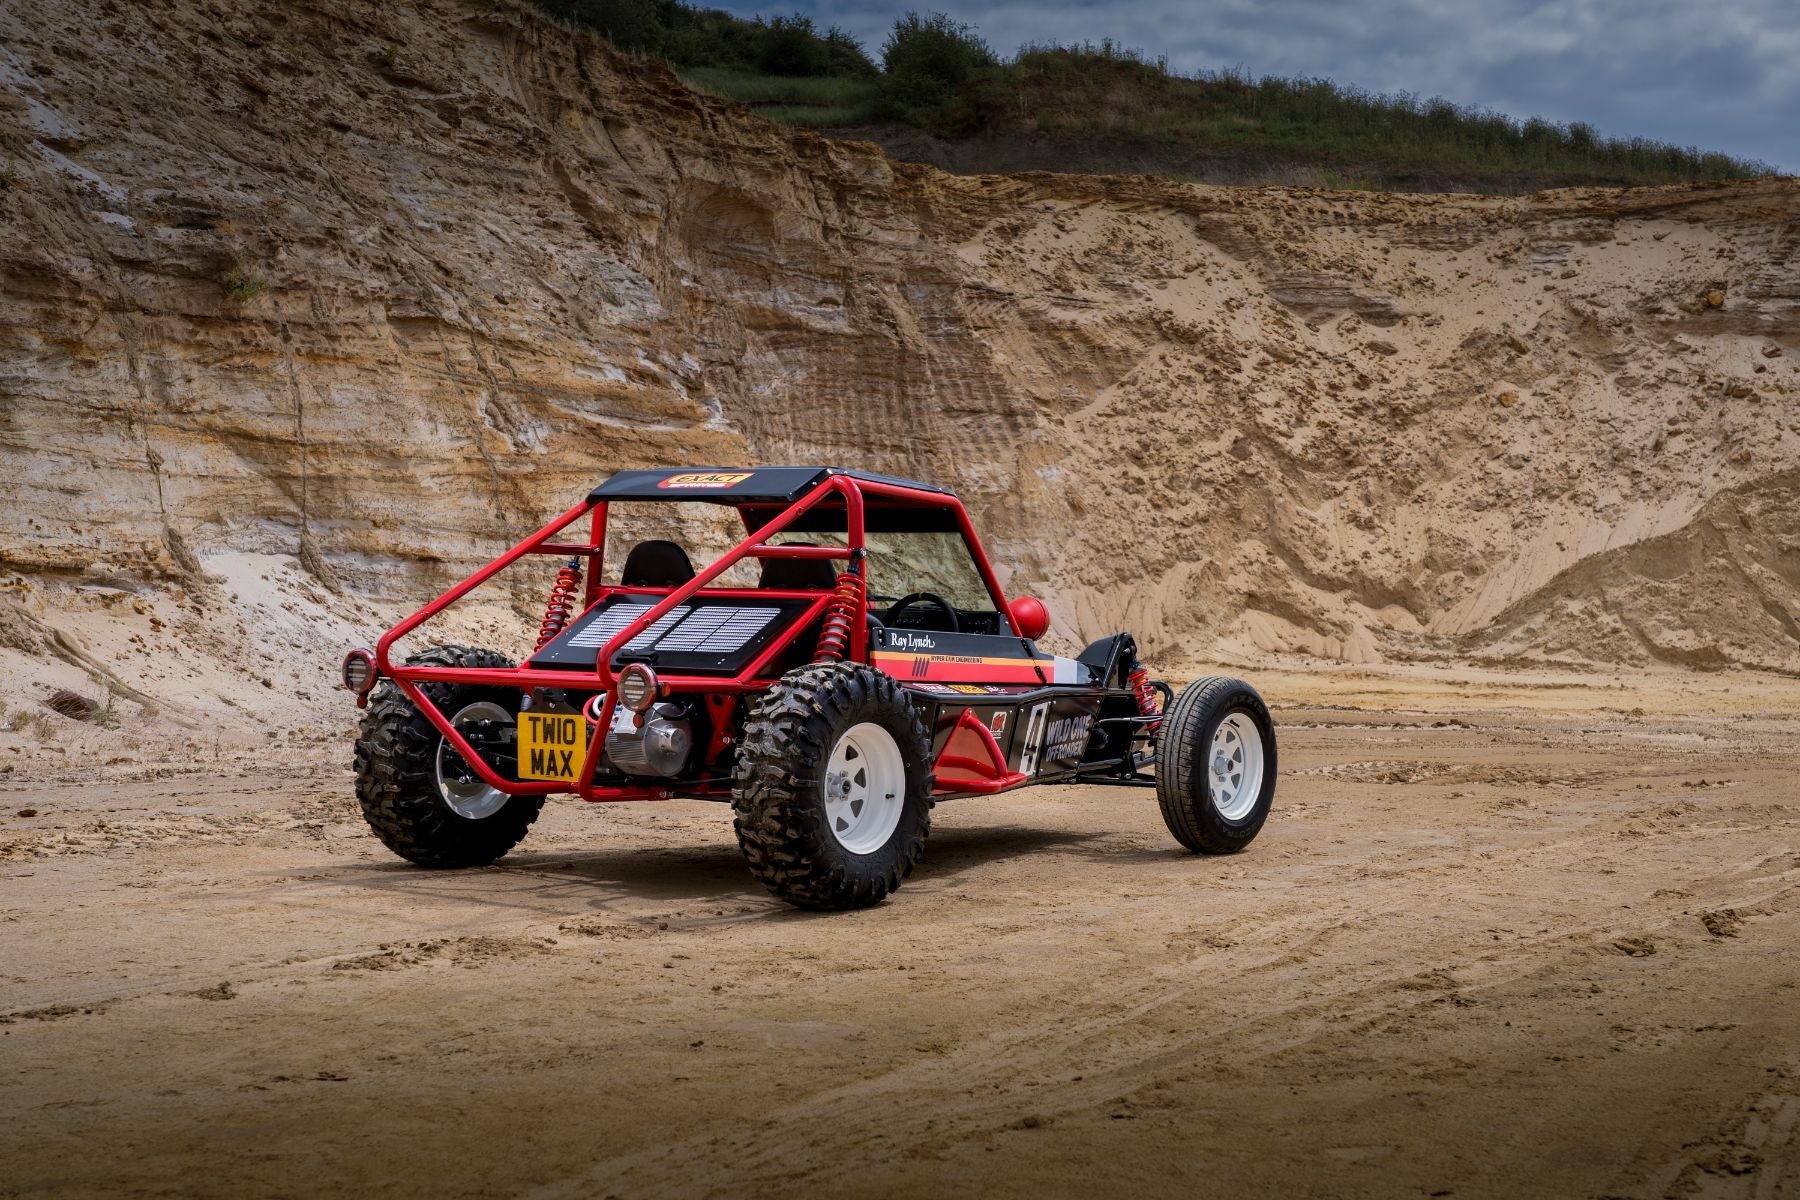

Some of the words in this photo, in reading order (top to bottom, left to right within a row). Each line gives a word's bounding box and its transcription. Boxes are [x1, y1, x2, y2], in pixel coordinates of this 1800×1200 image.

[677, 474, 743, 482] EXACT
[891, 633, 907, 651] Ray
[908, 634, 935, 651] Lynch
[528, 716, 576, 745] TW10
[1046, 718, 1071, 746] WILD
[1071, 714, 1092, 740] ONE
[531, 748, 573, 777] MAX
[1046, 740, 1083, 763] OFFROADER
